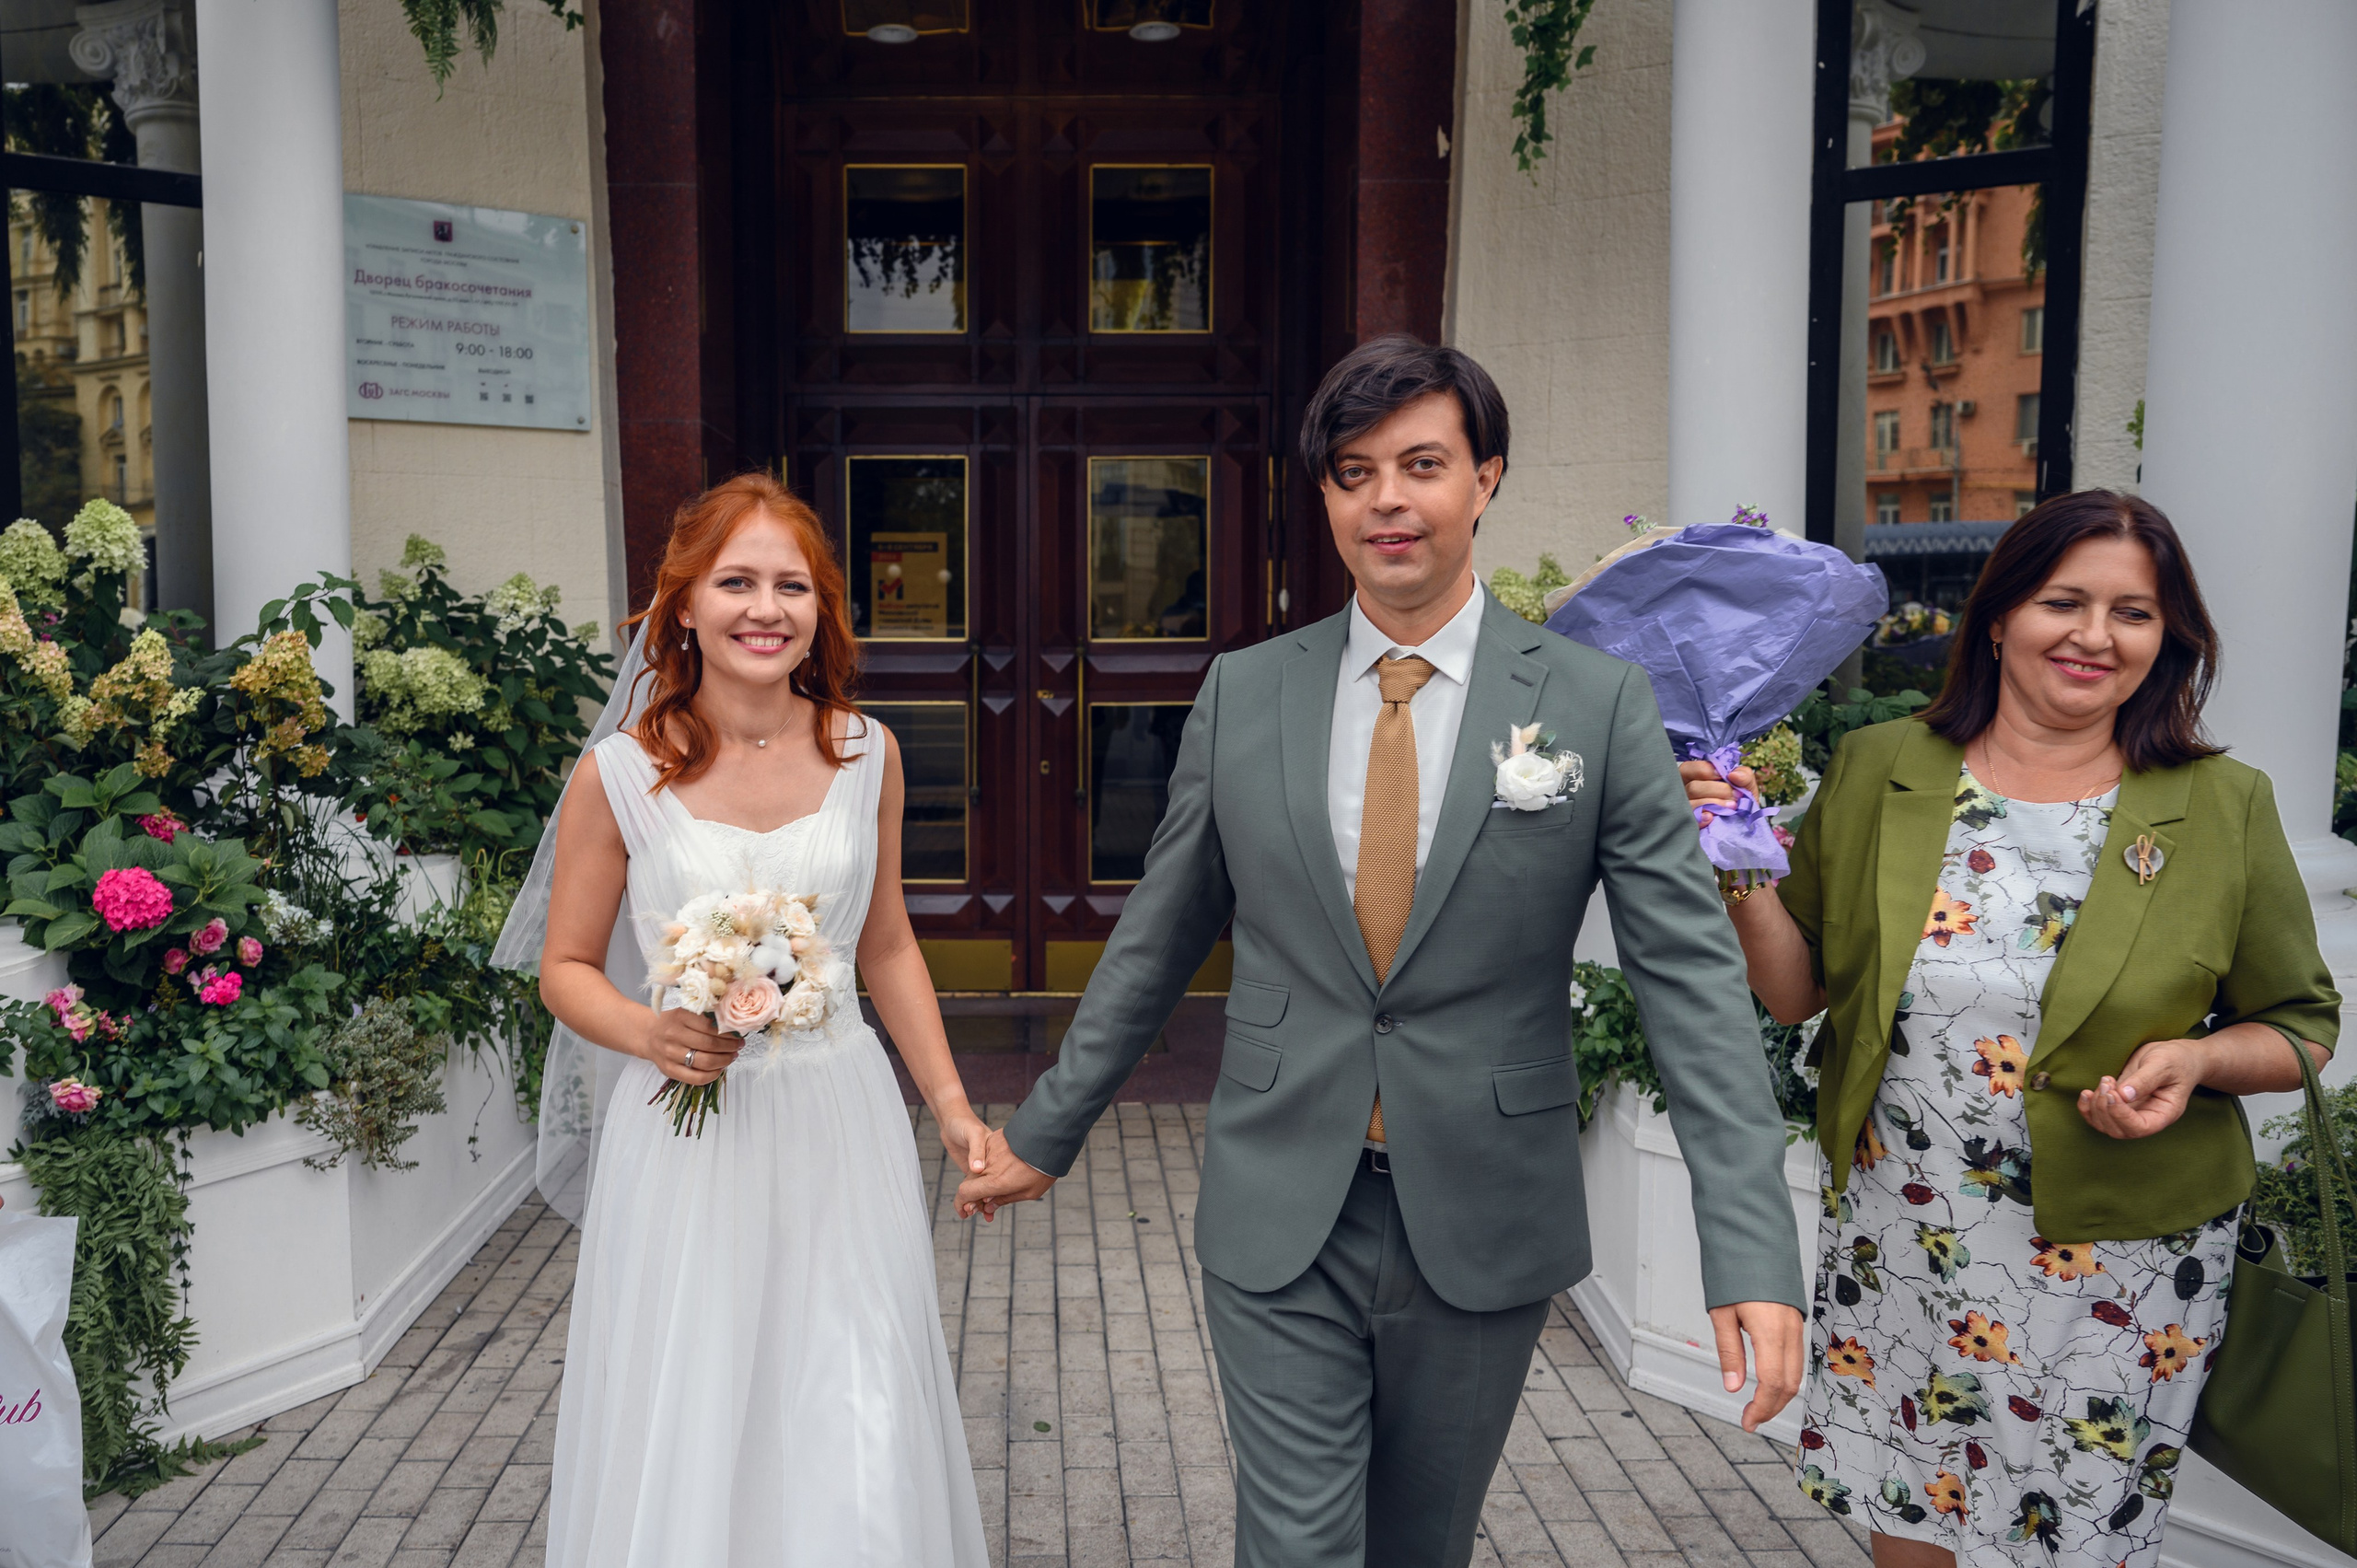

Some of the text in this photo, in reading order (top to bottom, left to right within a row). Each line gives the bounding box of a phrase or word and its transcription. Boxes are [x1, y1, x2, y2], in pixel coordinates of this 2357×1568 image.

[354, 269, 412, 289] Дворец
[415, 274, 532, 299] бракосочетания
[390, 316, 501, 337] РЕЖИМ РАБОТЫ
[455, 343, 485, 356] 9:00
[498, 345, 533, 359] 18:00
[411, 389, 450, 399] МОСКВЫ
[0, 1388, 41, 1425] ub
